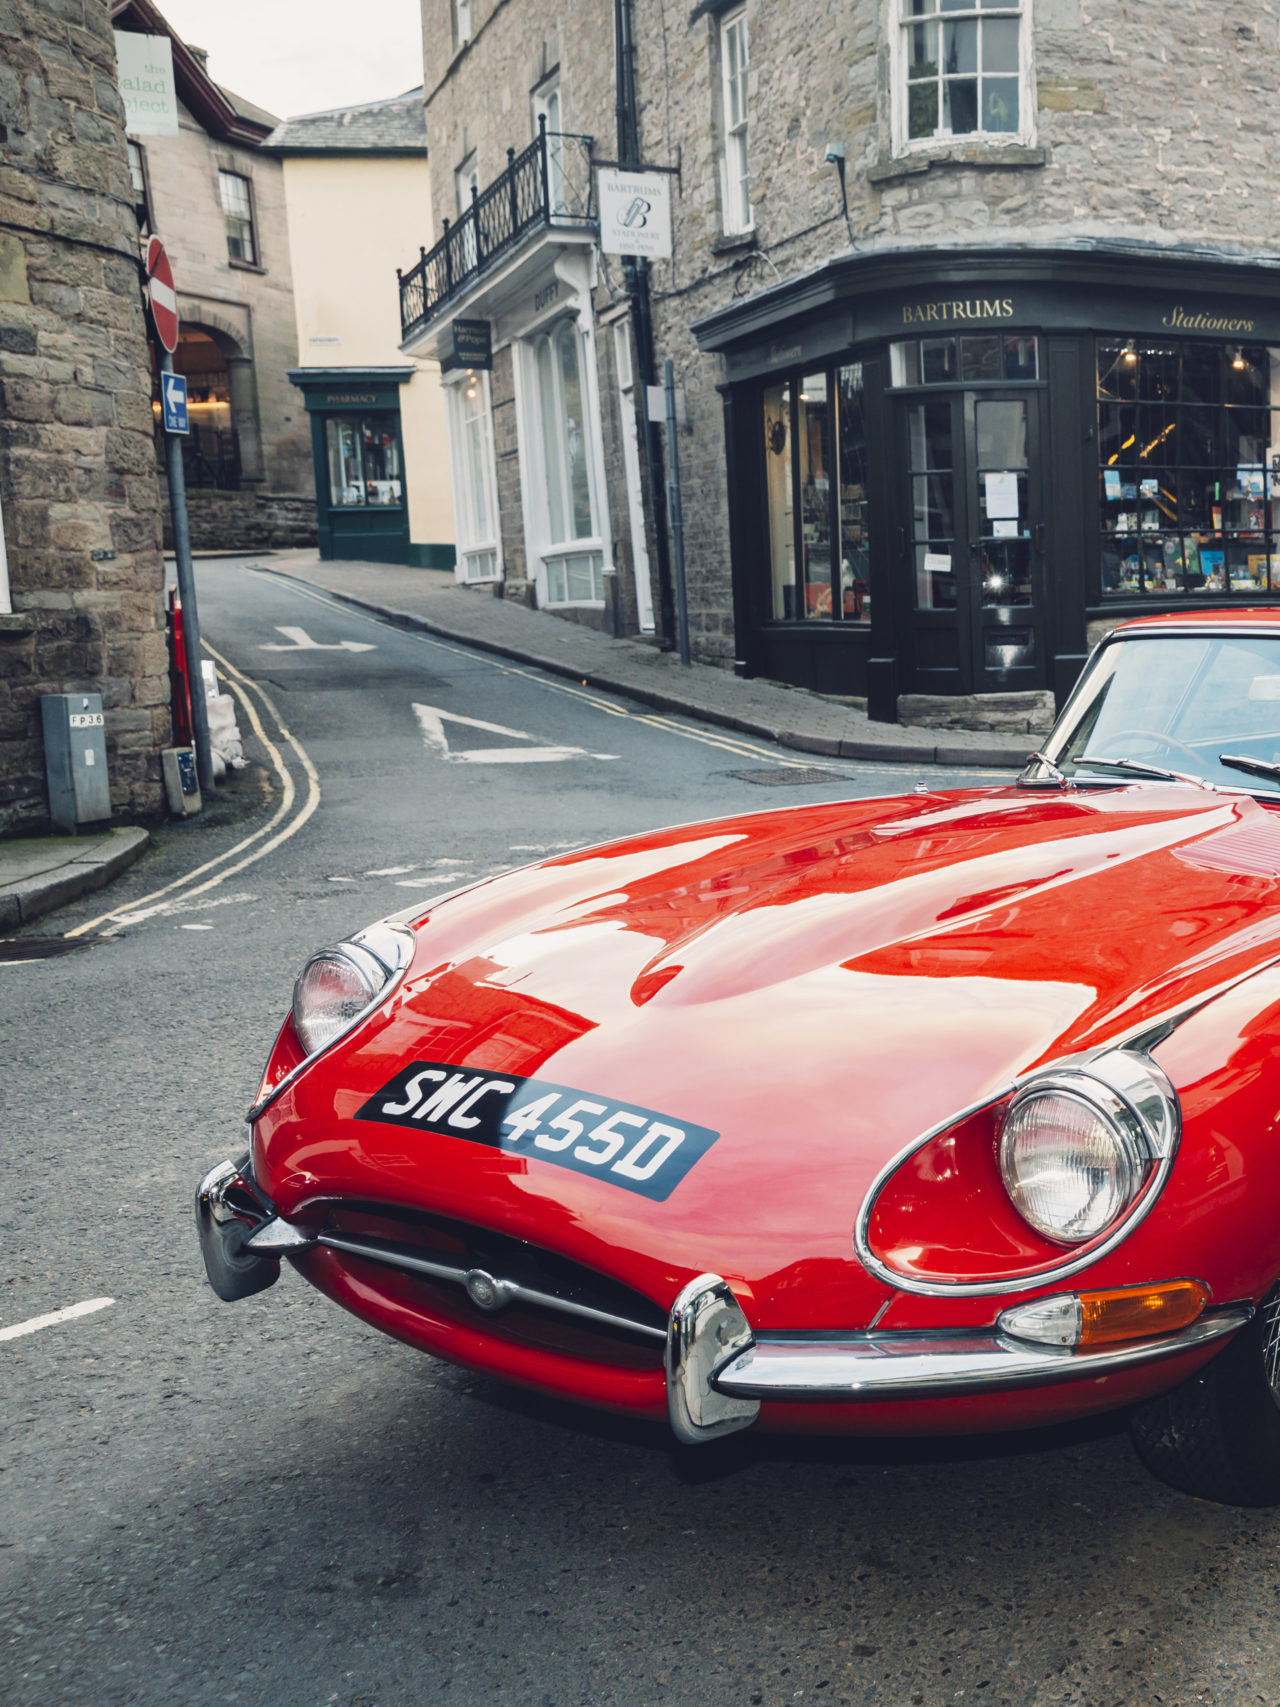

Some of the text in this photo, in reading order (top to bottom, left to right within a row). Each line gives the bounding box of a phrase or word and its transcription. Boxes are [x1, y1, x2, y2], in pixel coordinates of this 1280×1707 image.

[144, 64, 166, 74] the
[118, 77, 166, 95] alad
[535, 280, 559, 312] DUFFY
[902, 298, 1014, 324] BARTRUMS
[1162, 305, 1255, 332] Stationers
[381, 1069, 686, 1181] SWC 455D
